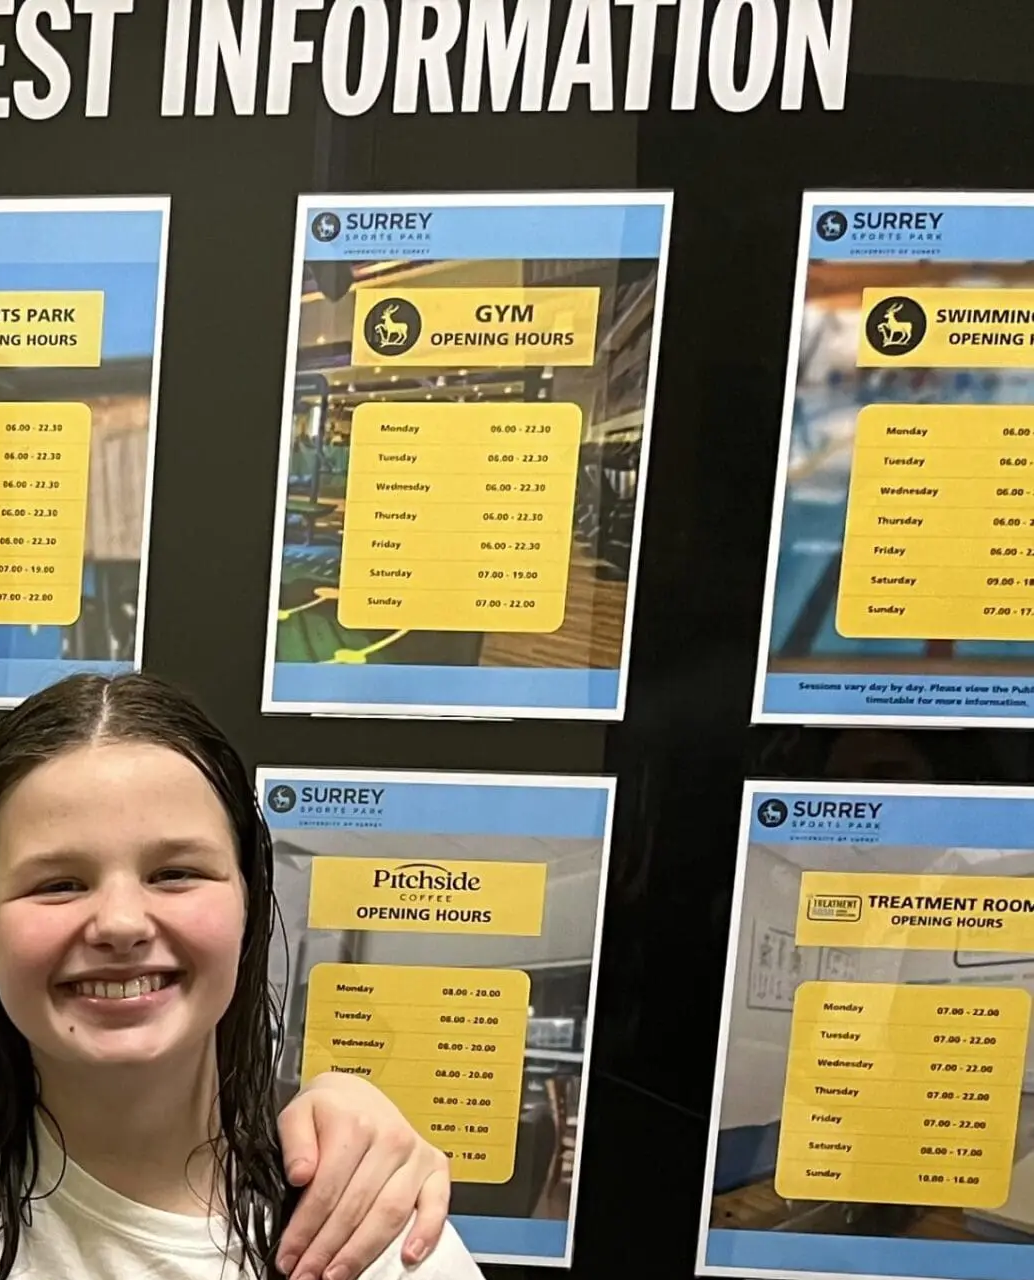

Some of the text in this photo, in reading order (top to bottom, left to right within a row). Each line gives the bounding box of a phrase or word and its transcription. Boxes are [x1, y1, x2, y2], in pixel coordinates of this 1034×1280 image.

[161, 0, 850, 116] INFORMATION
[347, 213, 432, 230] SURREY
[854, 212, 943, 229] SURREY
[27, 309, 75, 322] PARK
[476, 305, 533, 322] GYM
[937, 309, 1034, 323] SWIMMIN
[27, 335, 77, 345] HOURS
[431, 332, 574, 345] OPENING HOURS
[949, 333, 1023, 345] OPENING
[381, 425, 419, 434] Monday
[887, 428, 927, 436] Monday
[379, 454, 417, 464] Tuesday
[884, 457, 925, 467] Tuesday
[377, 483, 430, 492] Wednesday
[881, 487, 938, 497] Wednesday
[375, 512, 417, 521] Thursday
[878, 517, 923, 526] Thursday
[372, 540, 401, 550] Friday
[874, 547, 905, 556] Friday
[370, 569, 412, 578] Saturday
[871, 576, 916, 586] Saturday
[368, 598, 402, 607] Sunday
[868, 606, 905, 615] Sunday
[845, 684, 866, 692] vary
[870, 683, 888, 692] day
[891, 683, 903, 693] by
[302, 787, 384, 804] SURREY
[794, 801, 882, 819] SURREY
[374, 868, 481, 892] Pitchside
[400, 894, 452, 902] COFFEE
[869, 896, 977, 910] TREATMENT
[357, 907, 491, 922] OPENING HOURS
[892, 916, 1002, 928] OPENING HOURS
[337, 985, 374, 993] Monday
[824, 1003, 863, 1013] Monday
[335, 1011, 371, 1021] Tuesday
[821, 1031, 860, 1041] Tuesday
[333, 1039, 384, 1049] Wednesday
[818, 1059, 873, 1069] Wednesday
[815, 1087, 859, 1097] Thursday
[812, 1115, 842, 1124] Friday
[809, 1142, 852, 1152] Saturday
[806, 1170, 841, 1179] Sunday
